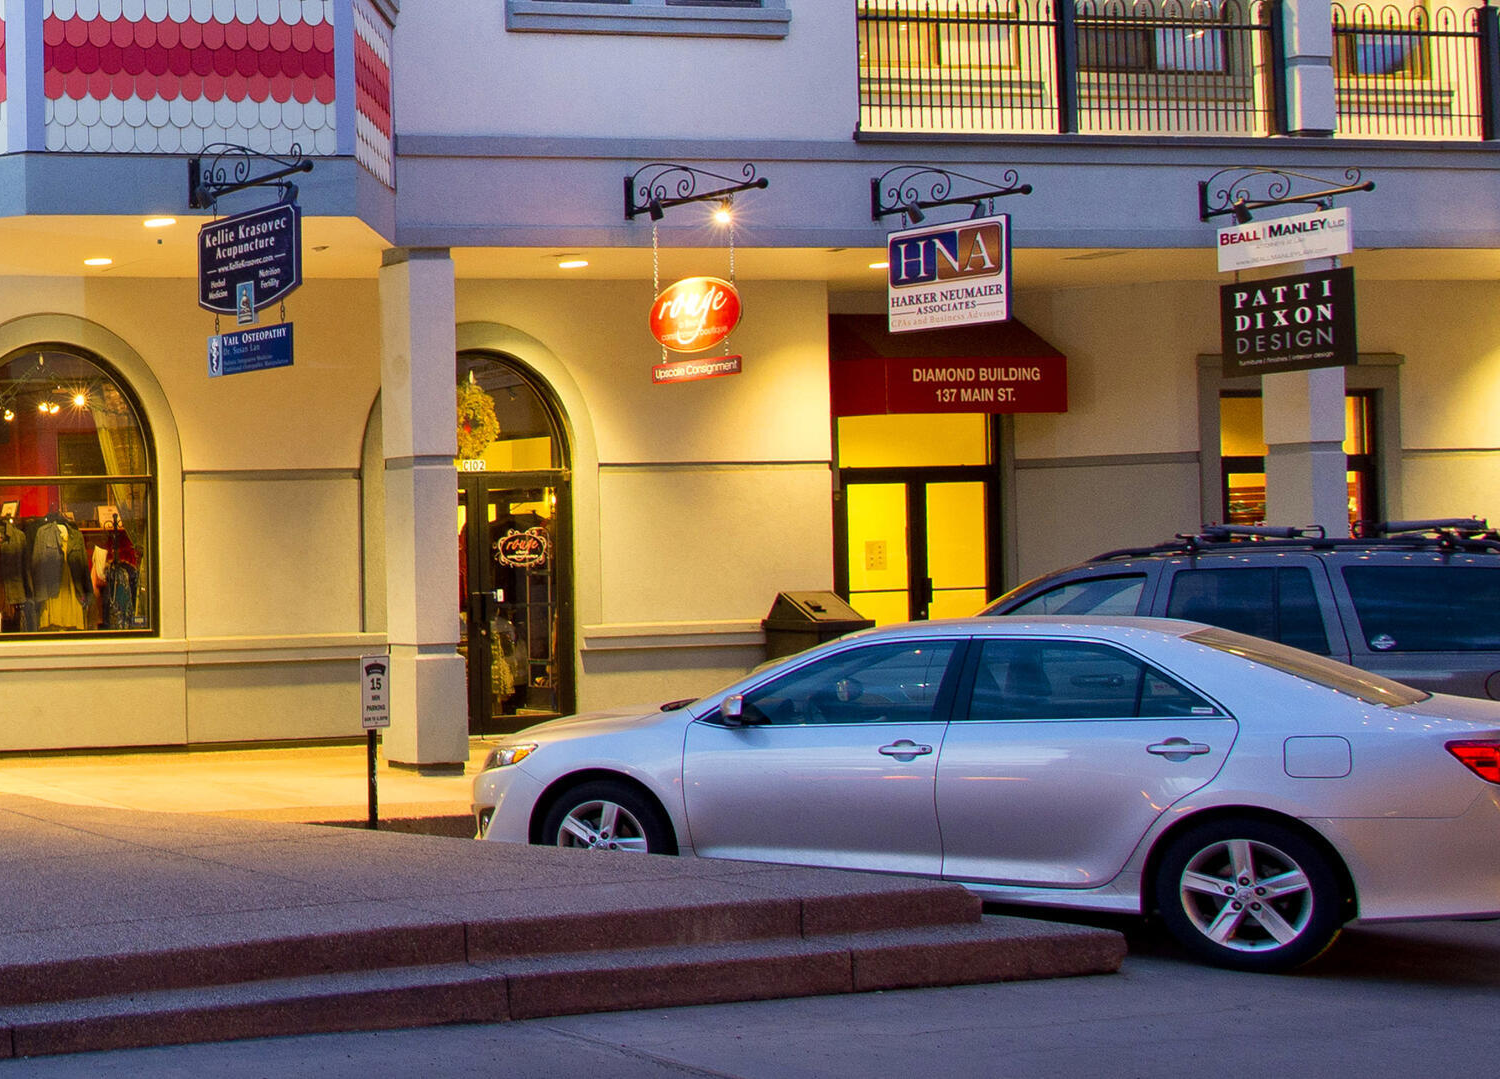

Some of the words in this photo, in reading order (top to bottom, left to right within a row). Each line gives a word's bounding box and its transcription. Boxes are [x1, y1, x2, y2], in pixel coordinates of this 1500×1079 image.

[205, 228, 235, 248] Kellie
[238, 217, 287, 239] Krasovec
[1220, 230, 1261, 246] BEALL
[1268, 218, 1327, 238] MANLEY
[216, 236, 275, 260] Acupuncture
[897, 229, 996, 281] HNA
[891, 292, 938, 308] HARKER
[940, 284, 1004, 302] NEUMAIER
[1234, 280, 1332, 309] PATTI
[658, 286, 727, 344] rouge
[913, 317, 927, 326] and
[930, 313, 966, 324] Business
[968, 309, 1004, 319] Advisors
[916, 301, 977, 315] ASSOCIATES
[1235, 303, 1333, 332] DIXON
[223, 336, 239, 346] VAIL
[242, 328, 287, 344] OSTEOPATHY
[1236, 327, 1334, 354] DESIGN
[655, 367, 685, 379] Upscale
[686, 359, 737, 375] Consignment
[912, 368, 975, 382] DIAMOND
[979, 367, 1041, 381] BUILDING
[935, 388, 957, 402] 137
[960, 388, 994, 402] MAIN
[997, 387, 1016, 401] ST.
[370, 677, 382, 690] 15
[366, 704, 386, 712] PARKING
